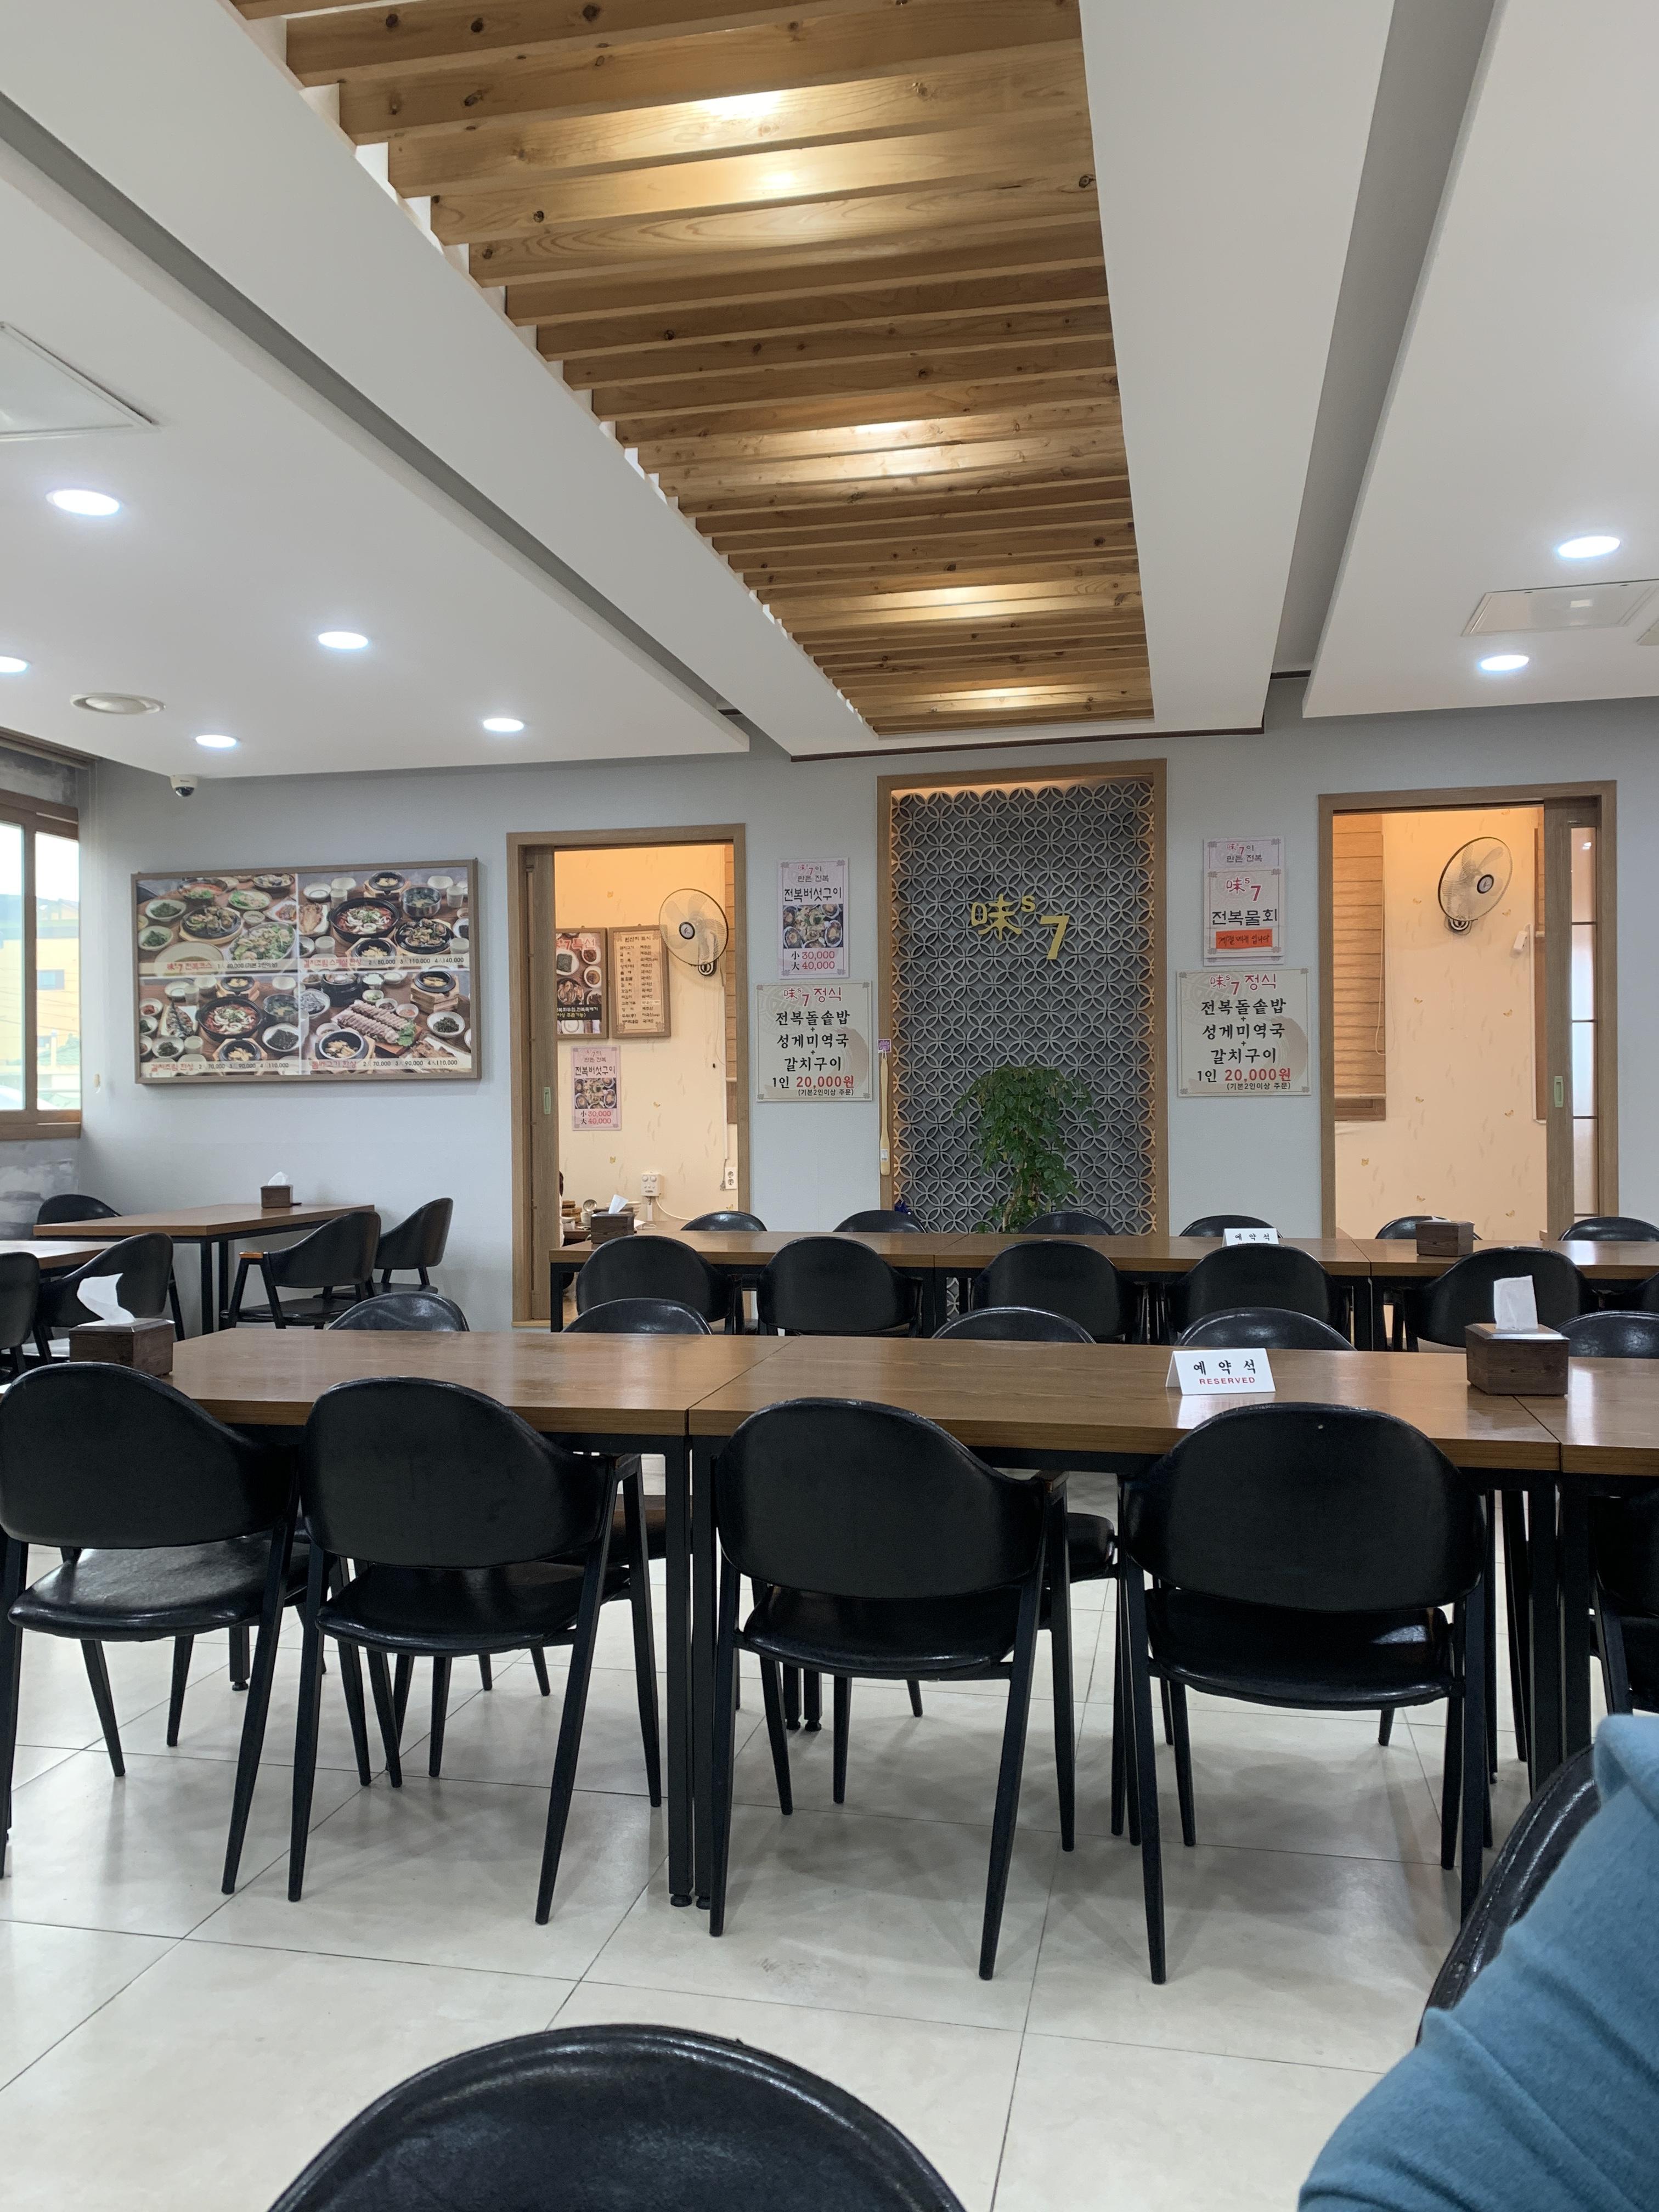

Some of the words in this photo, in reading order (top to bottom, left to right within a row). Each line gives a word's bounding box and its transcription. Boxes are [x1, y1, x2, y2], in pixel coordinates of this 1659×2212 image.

[1227, 855, 1243, 863] 만든
[1246, 854, 1262, 862] 전복
[785, 887, 842, 902] 전복버섯구이
[1212, 909, 1277, 926] 전복물회
[791, 951, 800, 960] 小
[802, 951, 835, 961] 30,000
[791, 961, 800, 970] 大
[802, 961, 835, 971] 40,000
[1245, 973, 1277, 991] 정식
[814, 986, 842, 1003] 정식
[1201, 997, 1286, 1015] 전복돌솥밥
[775, 1010, 850, 1026] 전복돌솥밥
[1202, 1023, 1285, 1040] 성게미역국
[777, 1033, 849, 1049] 성게미역국
[785, 1056, 842, 1072] 갈치구이
[1211, 1047, 1277, 1065] 갈치구이
[575, 1065, 615, 1076] 전복버섯구이
[1197, 1069, 1217, 1083] 1인
[1224, 1068, 1291, 1083] 20,000원
[772, 1076, 789, 1089] 1인
[797, 1075, 855, 1089] 20,000원
[1199, 1376, 1255, 1385] RESERVED
